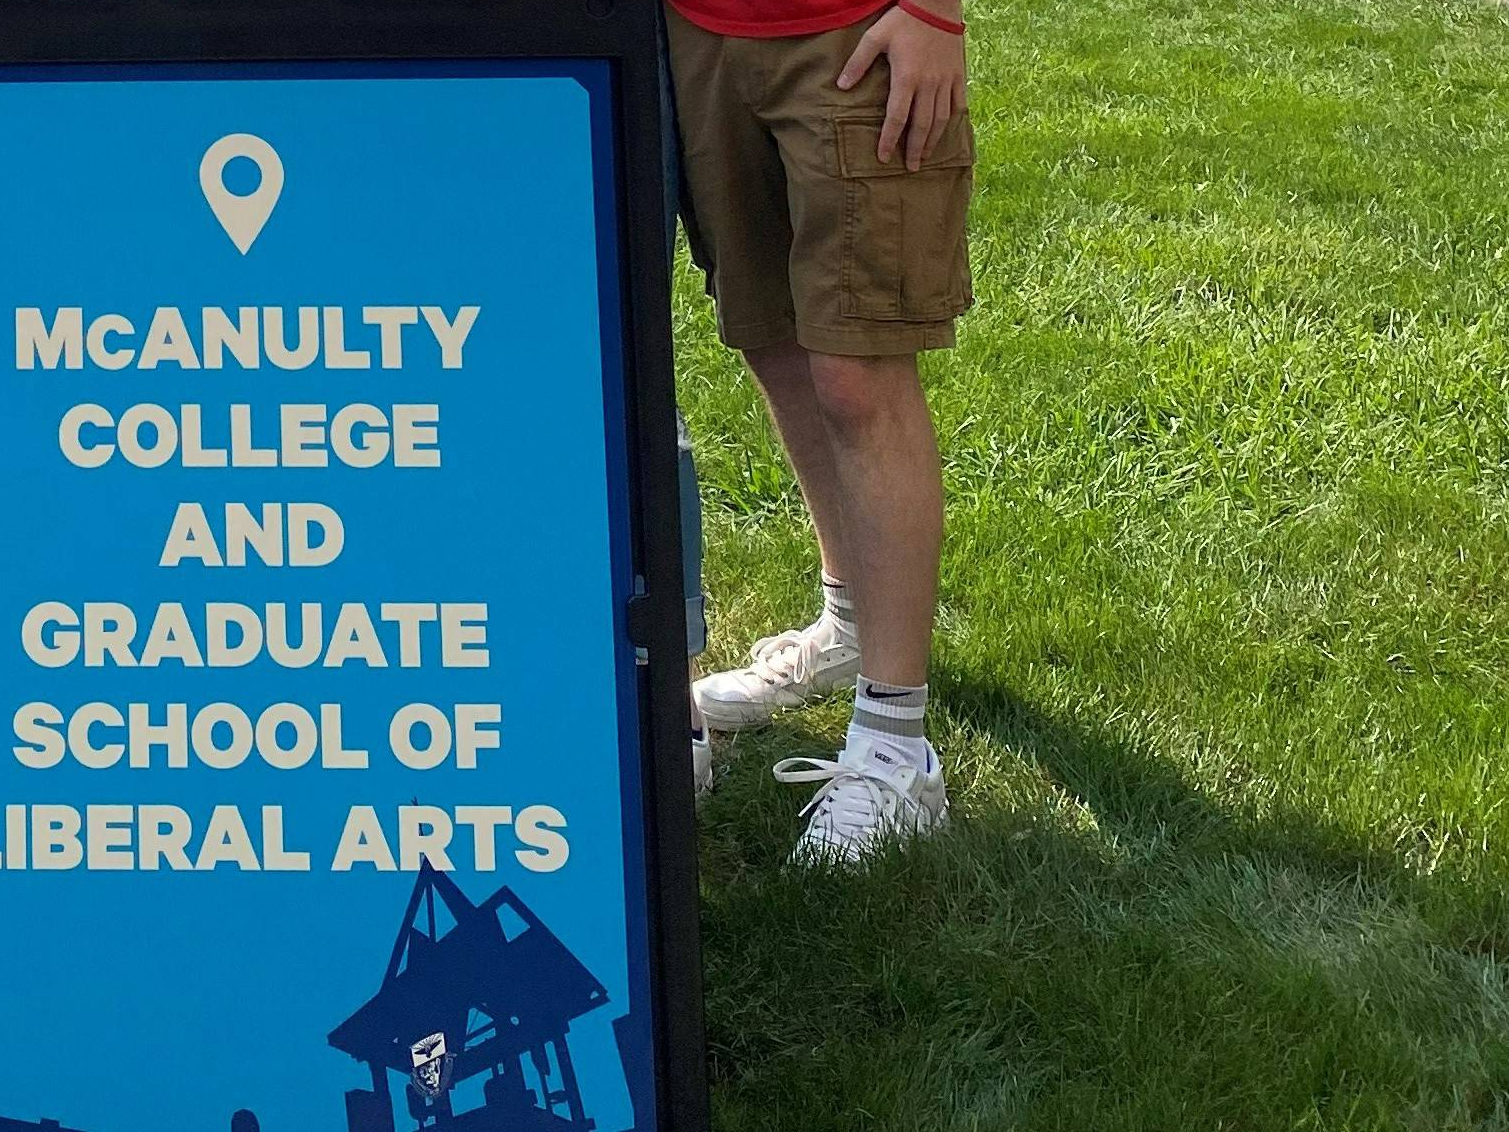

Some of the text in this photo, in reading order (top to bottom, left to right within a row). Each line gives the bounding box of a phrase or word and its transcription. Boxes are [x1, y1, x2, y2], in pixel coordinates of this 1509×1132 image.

[15, 306, 481, 370] McANULTY
[58, 403, 441, 468] COLLEGE
[158, 502, 345, 567] AND
[21, 601, 490, 668] GRADUATE
[12, 702, 502, 770] SCHOOL OF
[331, 805, 571, 872] ARTS
